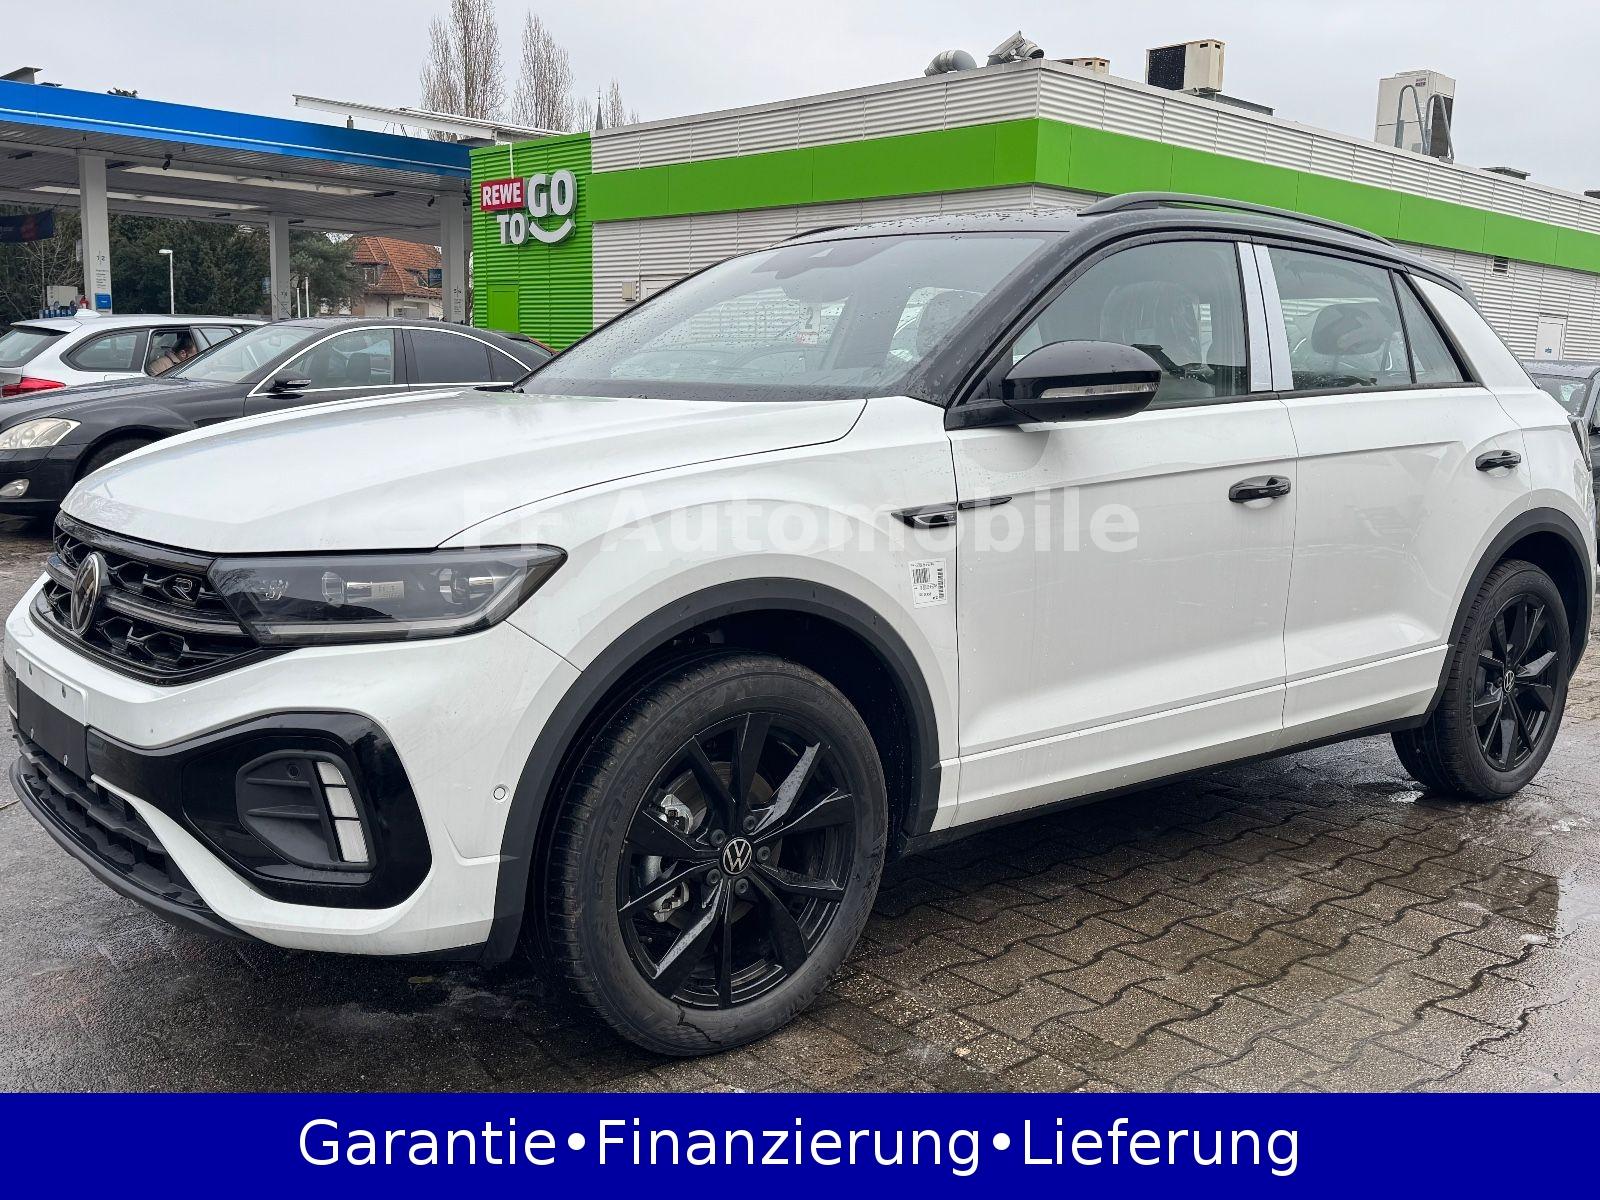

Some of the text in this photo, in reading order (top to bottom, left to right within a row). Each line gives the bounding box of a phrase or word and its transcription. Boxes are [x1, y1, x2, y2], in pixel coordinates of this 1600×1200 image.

[482, 181, 522, 207] REWE
[497, 169, 576, 245] TO GO
